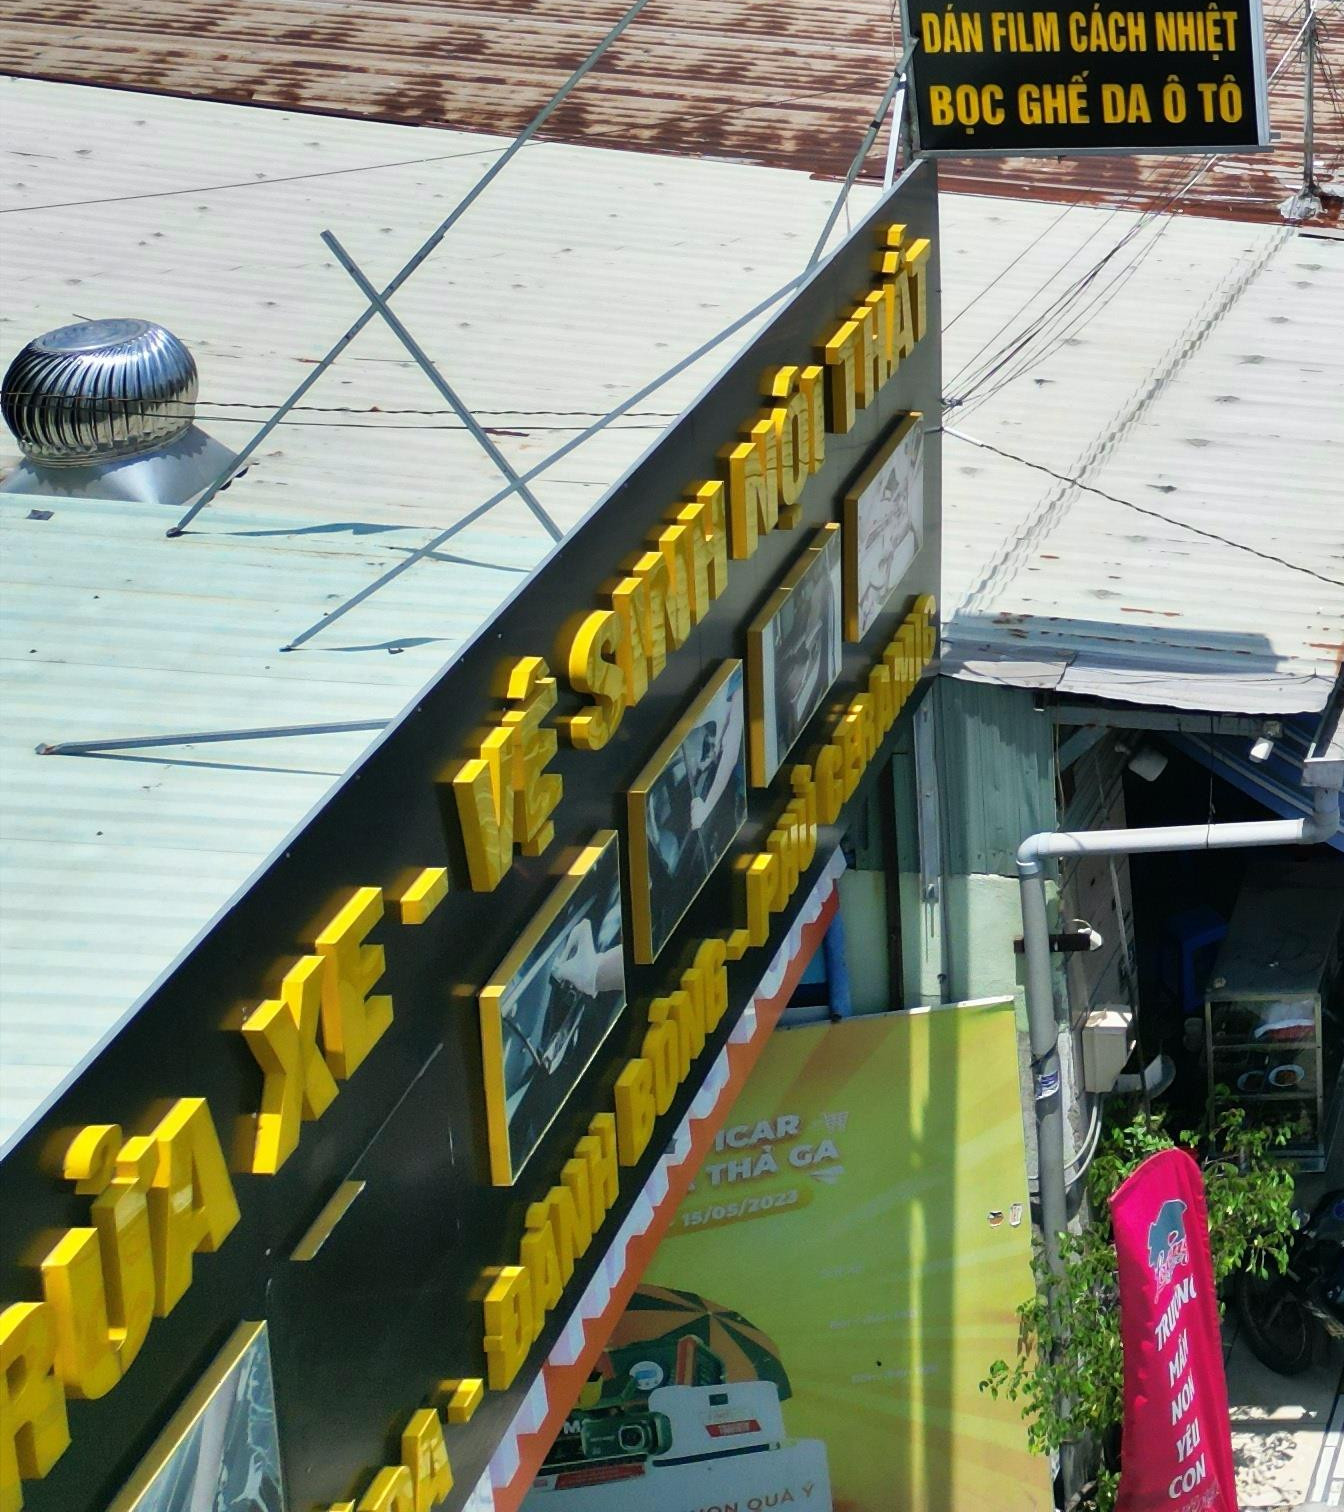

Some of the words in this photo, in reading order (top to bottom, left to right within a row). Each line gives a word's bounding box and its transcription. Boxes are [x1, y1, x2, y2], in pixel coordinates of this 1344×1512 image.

[920, 4, 982, 54] DÁN
[990, 12, 1061, 53] FILM
[1069, 3, 1147, 53] CÁCH
[1154, 2, 1238, 61] NHIỆT
[929, 84, 1005, 135] BỌC
[1017, 70, 1091, 125] GHẾ
[1101, 83, 1152, 124] DA
[1162, 74, 1187, 124] Ô
[1197, 74, 1243, 124] TÔ
[0, 1096, 242, 1510] RỬA
[238, 884, 395, 1177] XE
[450, 655, 563, 893] VỆ
[565, 479, 728, 752] SINH
[729, 365, 826, 561] NỘI
[824, 223, 932, 435] THẤT
[482, 1110, 622, 1392] ĐÁNH
[613, 937, 731, 1168] BÓNG
[788, 1138, 840, 1168] GA
[683, 1189, 798, 1228] 15/05/2023
[1168, 1452, 1207, 1500] CON
